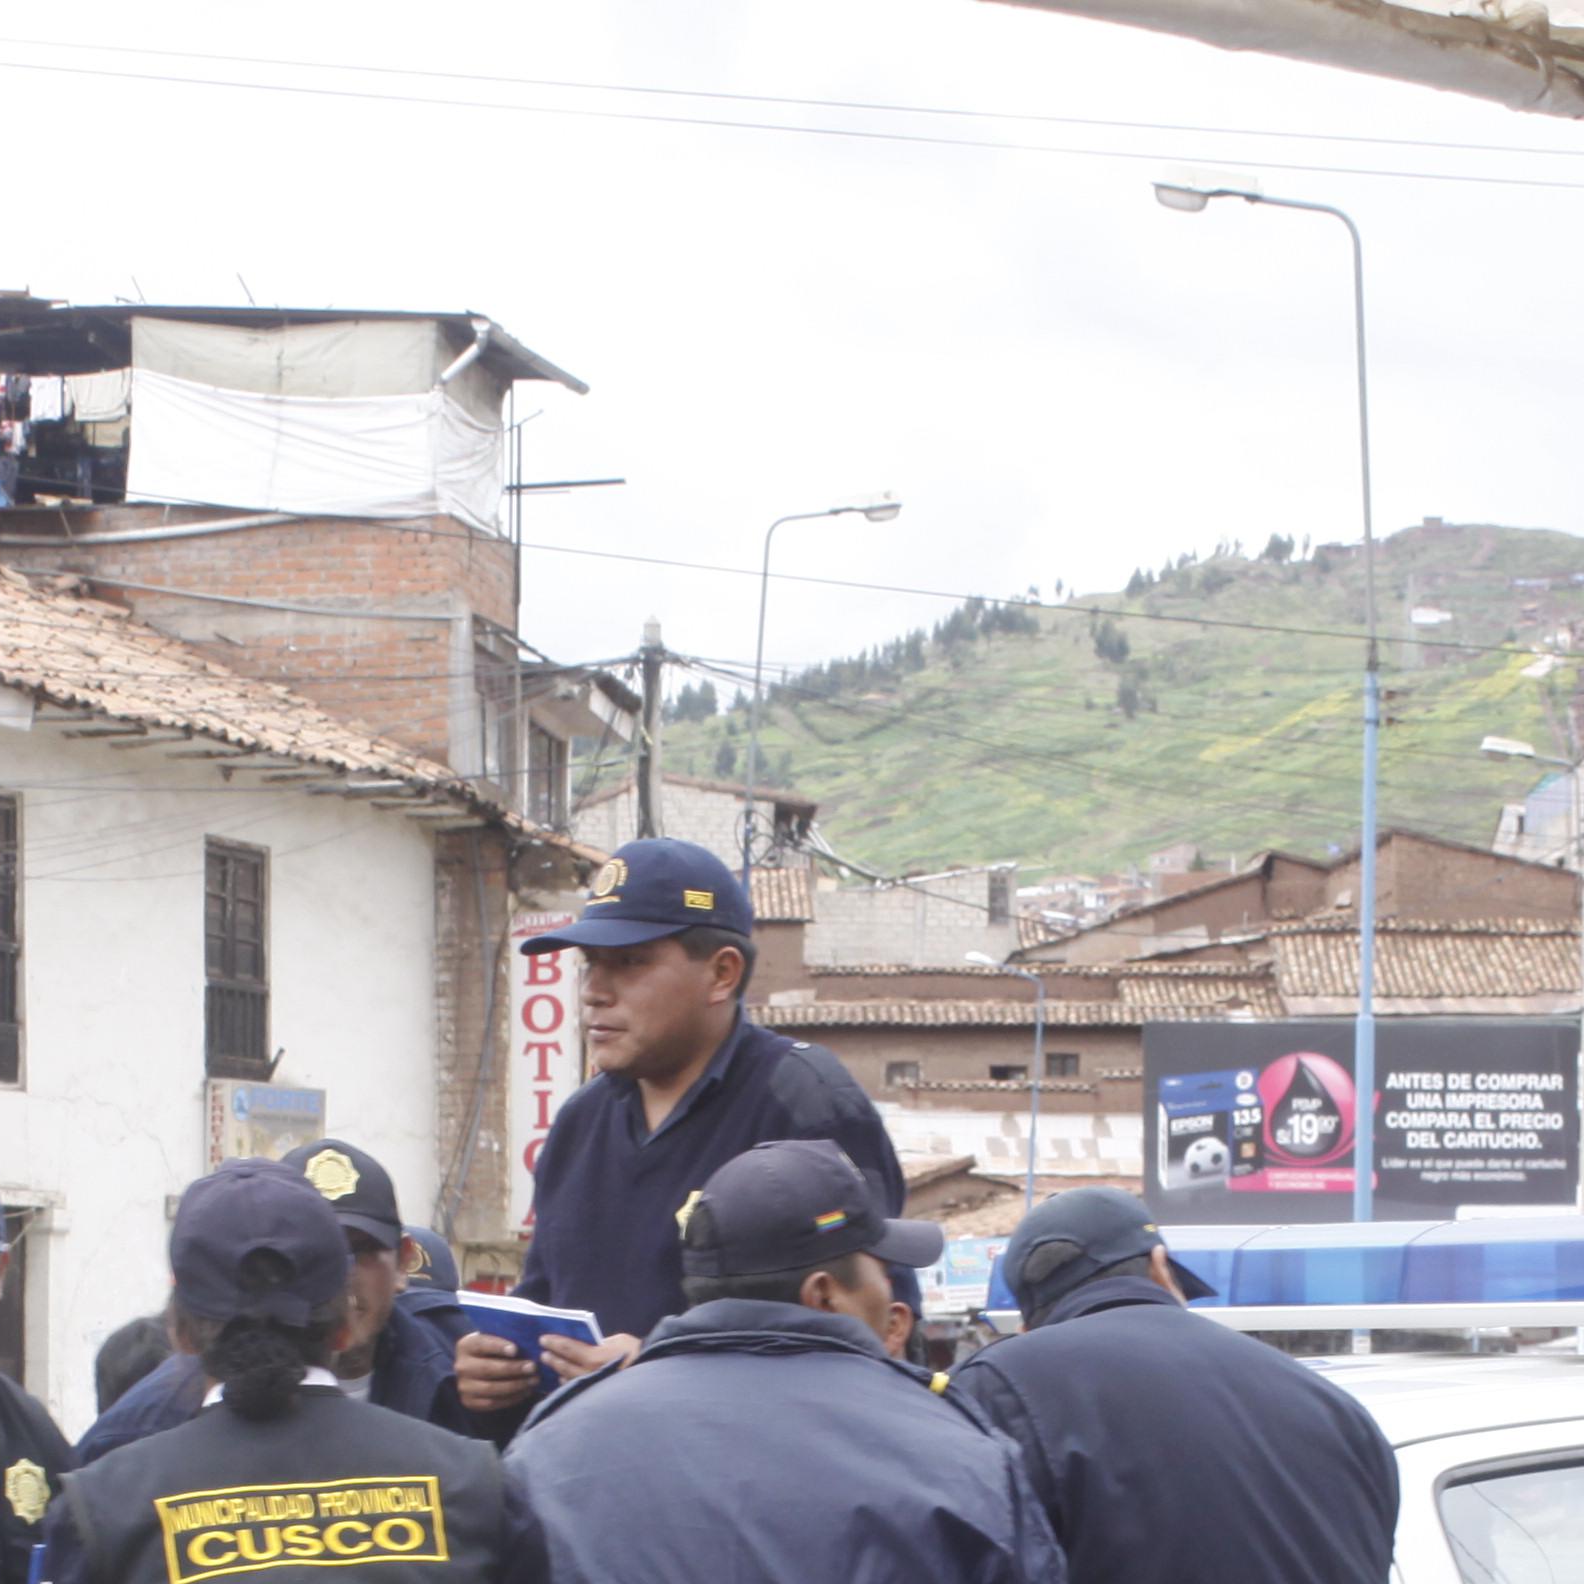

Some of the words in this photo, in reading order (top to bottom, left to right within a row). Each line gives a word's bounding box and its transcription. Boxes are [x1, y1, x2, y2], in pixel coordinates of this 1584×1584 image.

[521, 949, 565, 1226] BOTI
[1385, 1072, 1444, 1090] ANTES
[1446, 1073, 1472, 1090] DE
[1474, 1073, 1564, 1091] COMPRAR
[1405, 1092, 1444, 1110] UNA
[1445, 1092, 1544, 1110] IMPRESORA
[1170, 1114, 1215, 1132] EPSON
[1385, 1111, 1471, 1129] COMPARA
[1474, 1112, 1496, 1129] EL
[1499, 1112, 1564, 1130] PRECIO
[1405, 1131, 1441, 1149] DEL
[1442, 1131, 1543, 1149] CARTUCHO.
[166, 1493, 315, 1533] MUNICIPALIDAD
[319, 1487, 433, 1518] PROVINCIAL
[186, 1517, 425, 1567] CUSCO
